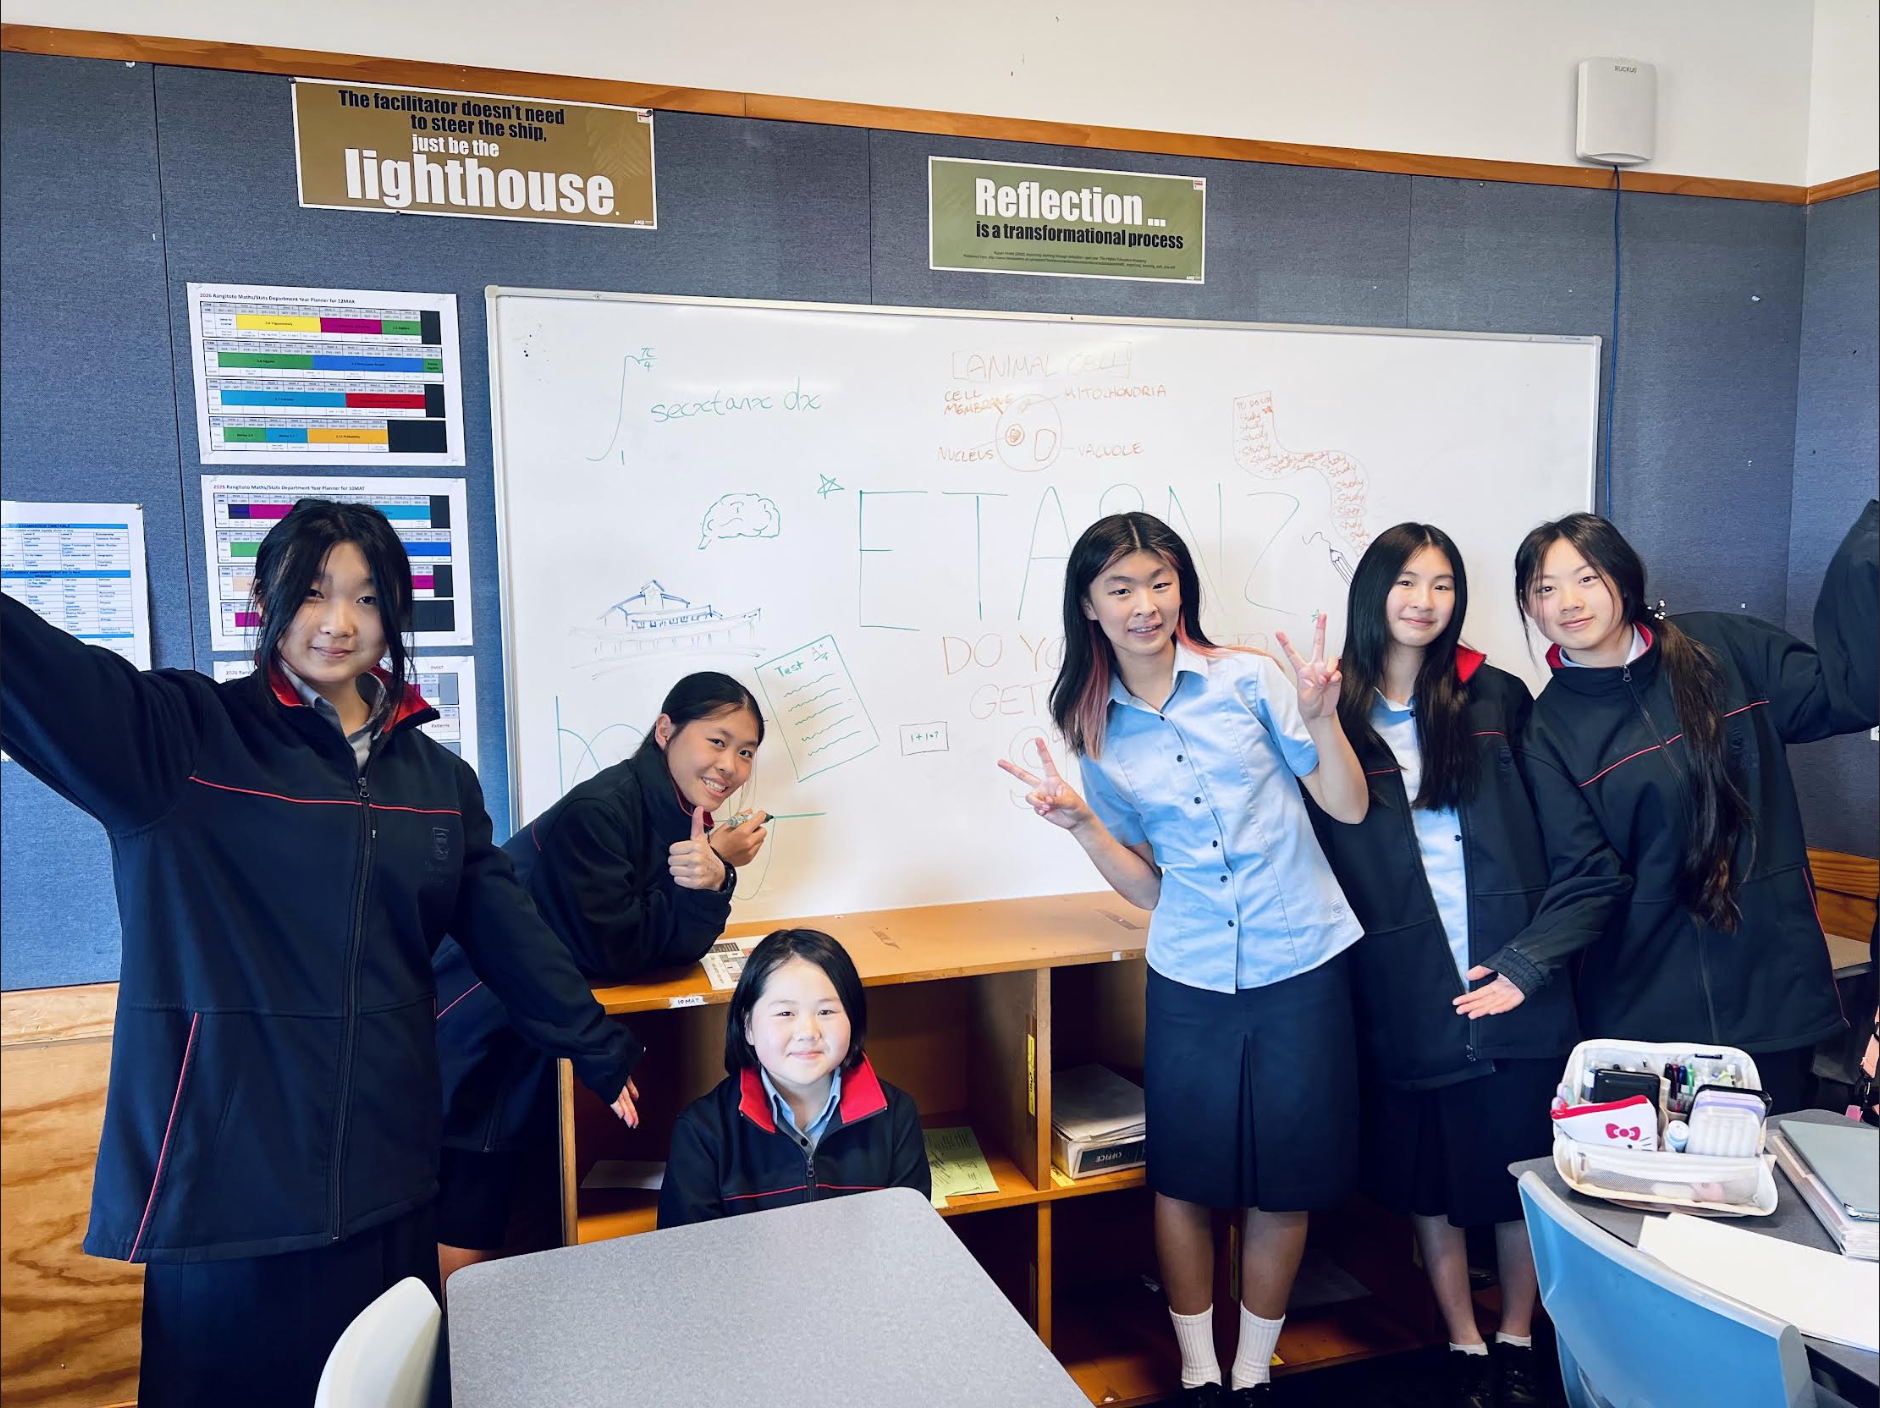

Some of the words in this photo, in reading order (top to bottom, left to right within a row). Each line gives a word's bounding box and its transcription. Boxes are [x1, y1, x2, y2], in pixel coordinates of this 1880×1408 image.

[338, 89, 370, 108] The
[373, 92, 458, 115] facilitator
[461, 99, 523, 122] doesn't
[525, 107, 565, 125] need
[410, 114, 428, 130] to
[431, 116, 475, 133] steer
[478, 118, 505, 135] the
[508, 121, 548, 143] ship,
[411, 133, 446, 153] just
[448, 136, 470, 155] be
[473, 138, 500, 157] the
[344, 148, 620, 216] lighthouse.
[975, 177, 1143, 226] Reflection
[976, 220, 990, 238] is
[992, 224, 1001, 239] a
[1003, 223, 1126, 246] transformational
[1128, 232, 1184, 249] process
[966, 354, 1058, 382] ANIMAL
[944, 389, 983, 402] CELL
[938, 445, 995, 463] NUCLEUS
[774, 660, 805, 677] Test
[942, 633, 1003, 676] DO
[970, 679, 1053, 720] GET
